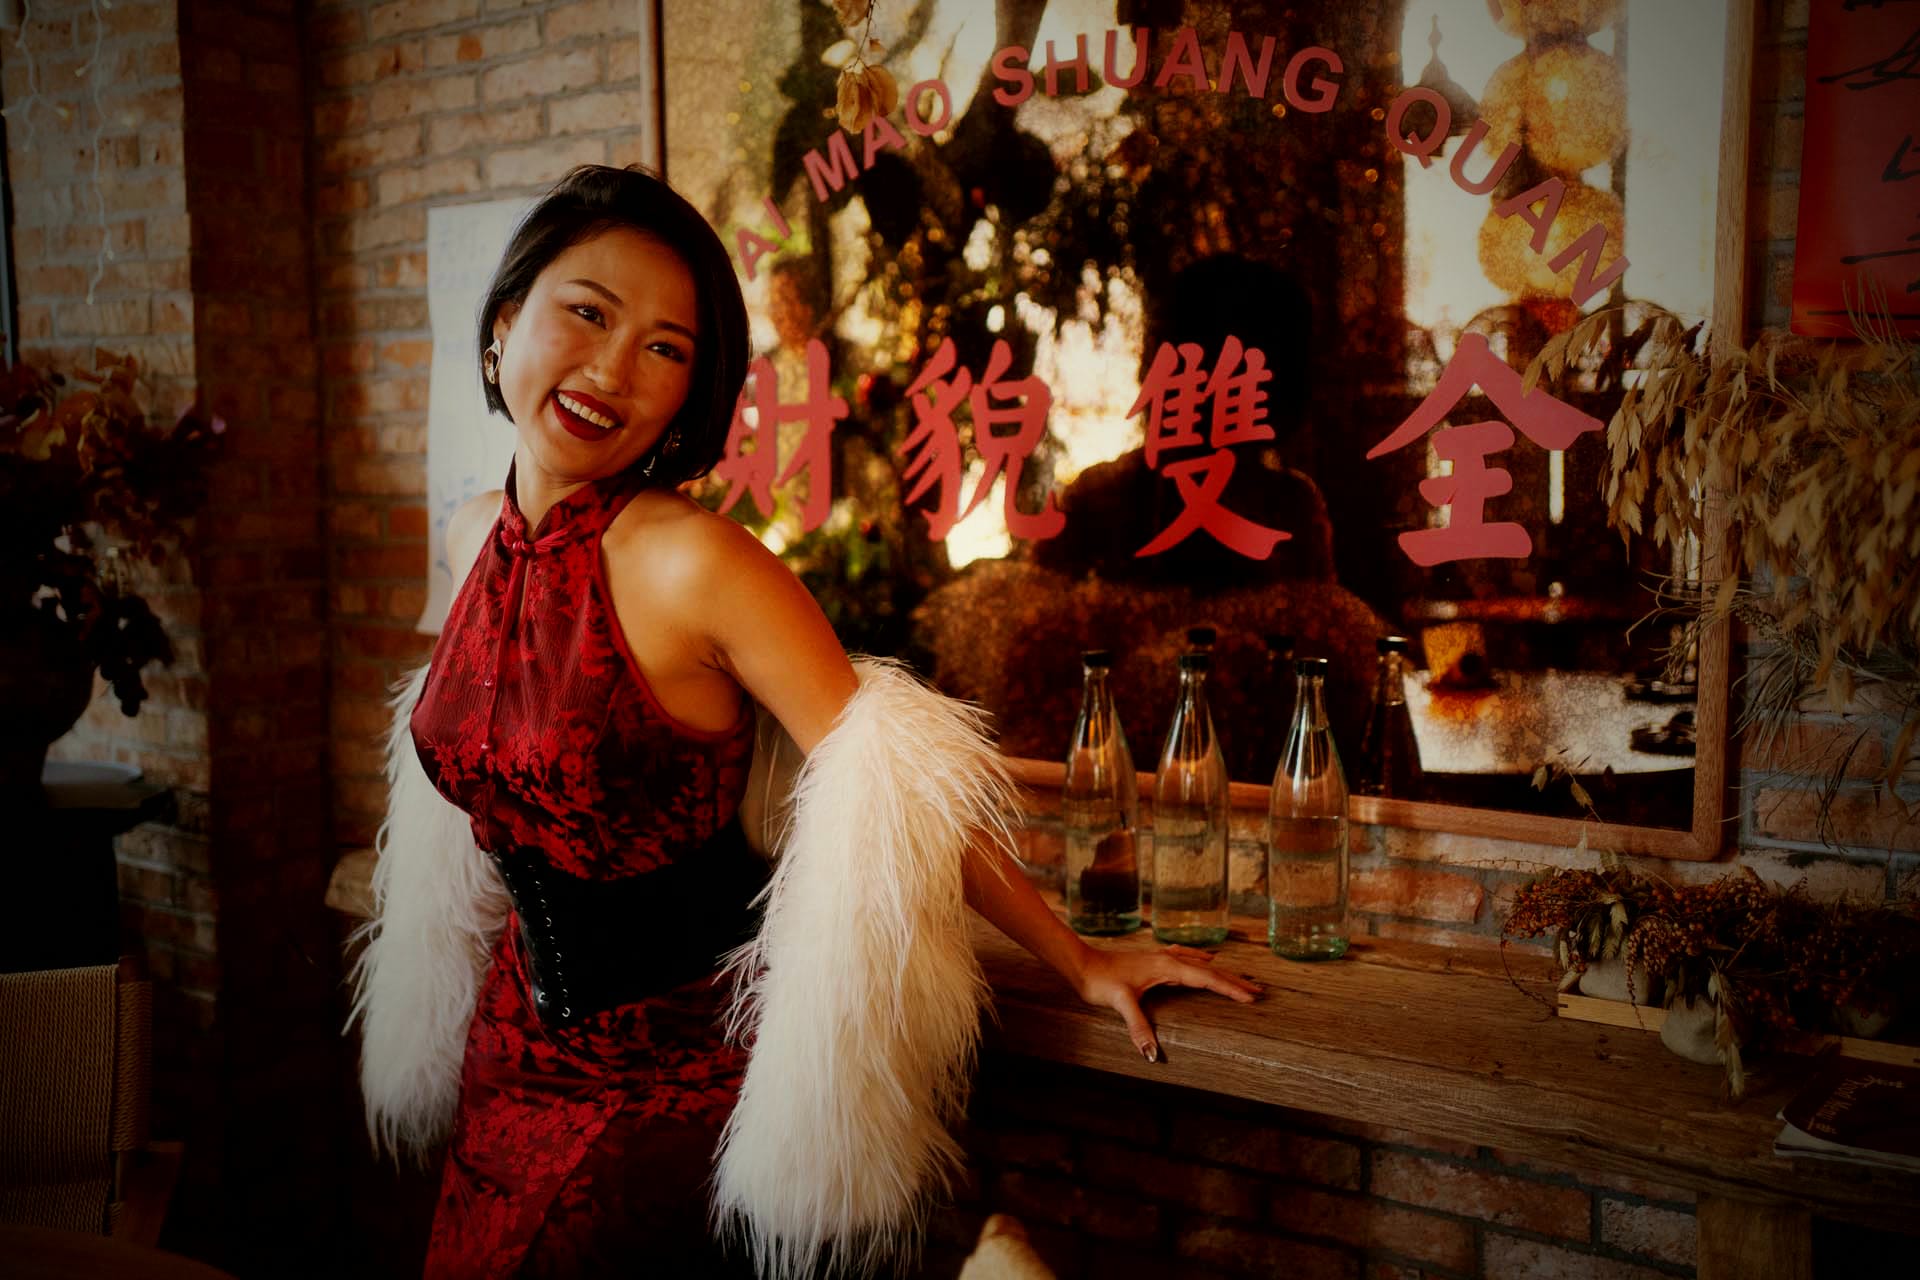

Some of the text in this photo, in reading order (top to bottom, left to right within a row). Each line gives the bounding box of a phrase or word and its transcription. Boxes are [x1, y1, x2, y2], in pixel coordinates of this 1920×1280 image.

[736, 27, 1631, 306] AI MAO SHUANG QUAN
